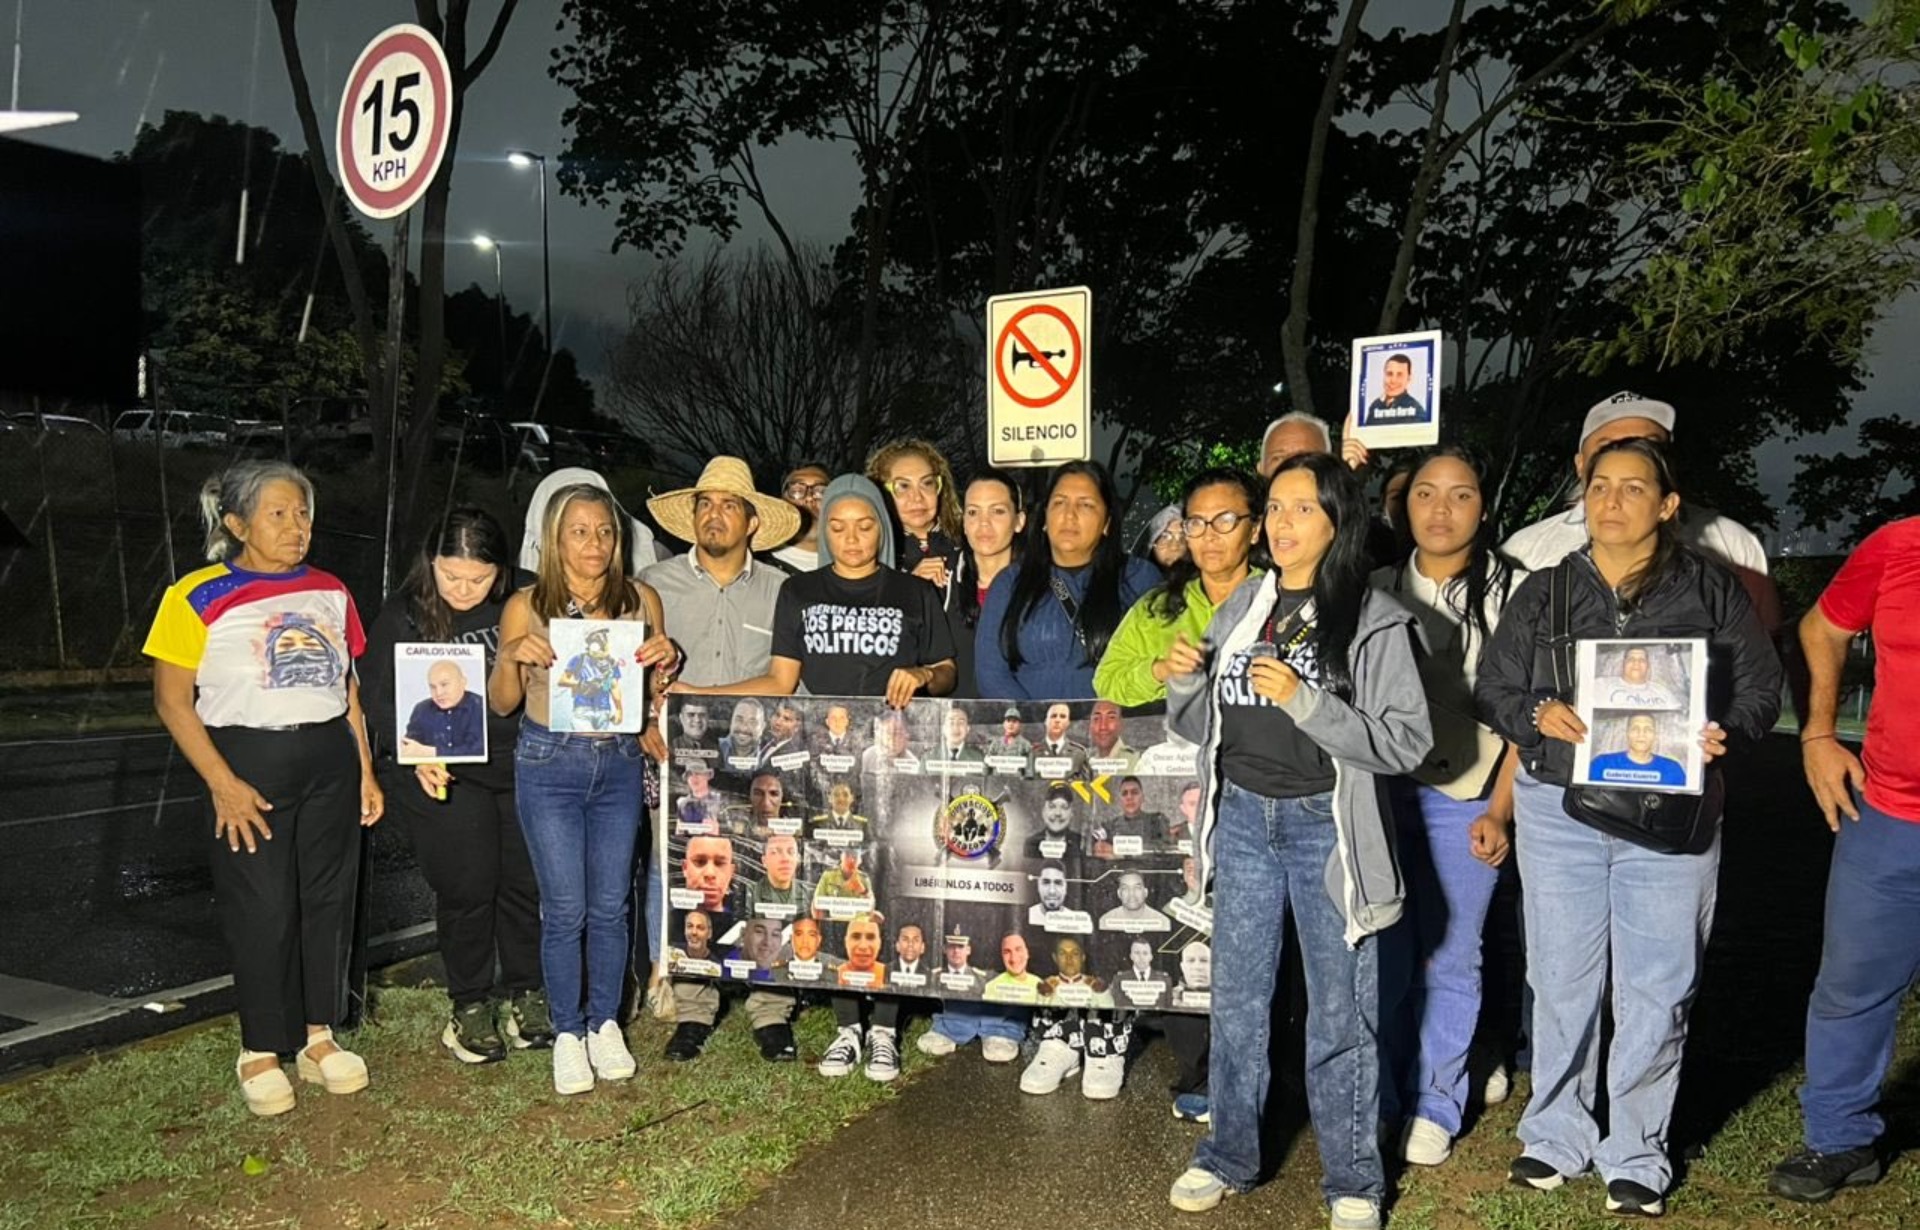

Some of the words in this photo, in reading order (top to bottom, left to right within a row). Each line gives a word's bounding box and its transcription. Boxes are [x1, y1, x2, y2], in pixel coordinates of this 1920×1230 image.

[362, 71, 420, 156] 15
[373, 157, 407, 183] KPH
[1001, 423, 1078, 442] SILENCIO
[847, 606, 858, 616] A
[859, 606, 904, 619] TODOS
[804, 614, 828, 633] LOS
[831, 615, 903, 636] PRESOS
[406, 646, 445, 656] CARLOS
[445, 646, 472, 656] VIDAL
[803, 632, 900, 657] POLITICOS
[973, 881, 982, 891] A
[983, 882, 1015, 893] TODOS
